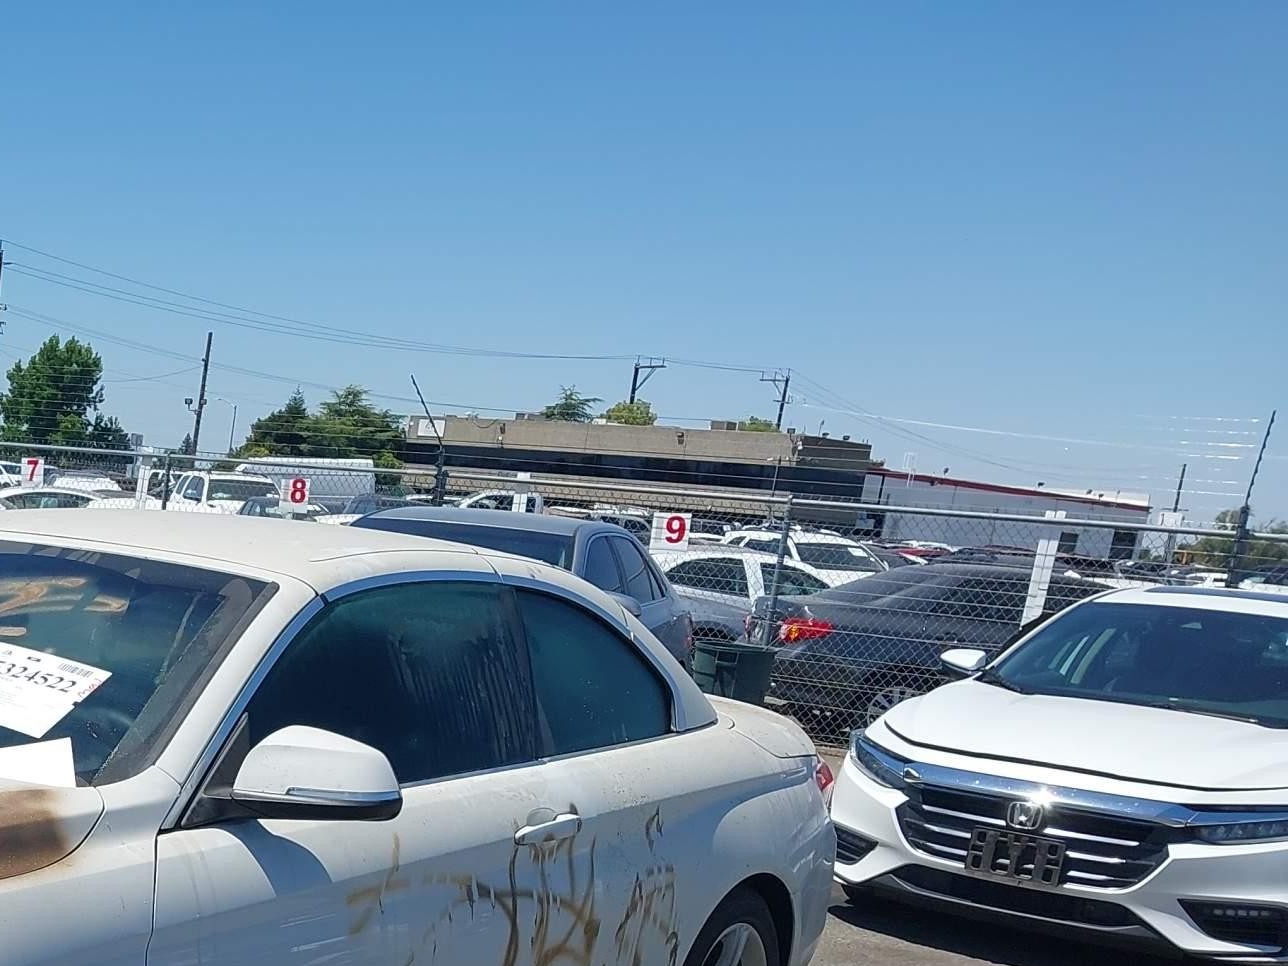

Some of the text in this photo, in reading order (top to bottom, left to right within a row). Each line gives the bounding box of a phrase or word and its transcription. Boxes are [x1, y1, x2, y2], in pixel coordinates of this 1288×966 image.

[27, 459, 39, 481] 7
[290, 478, 307, 503] 8
[665, 515, 687, 544] 9
